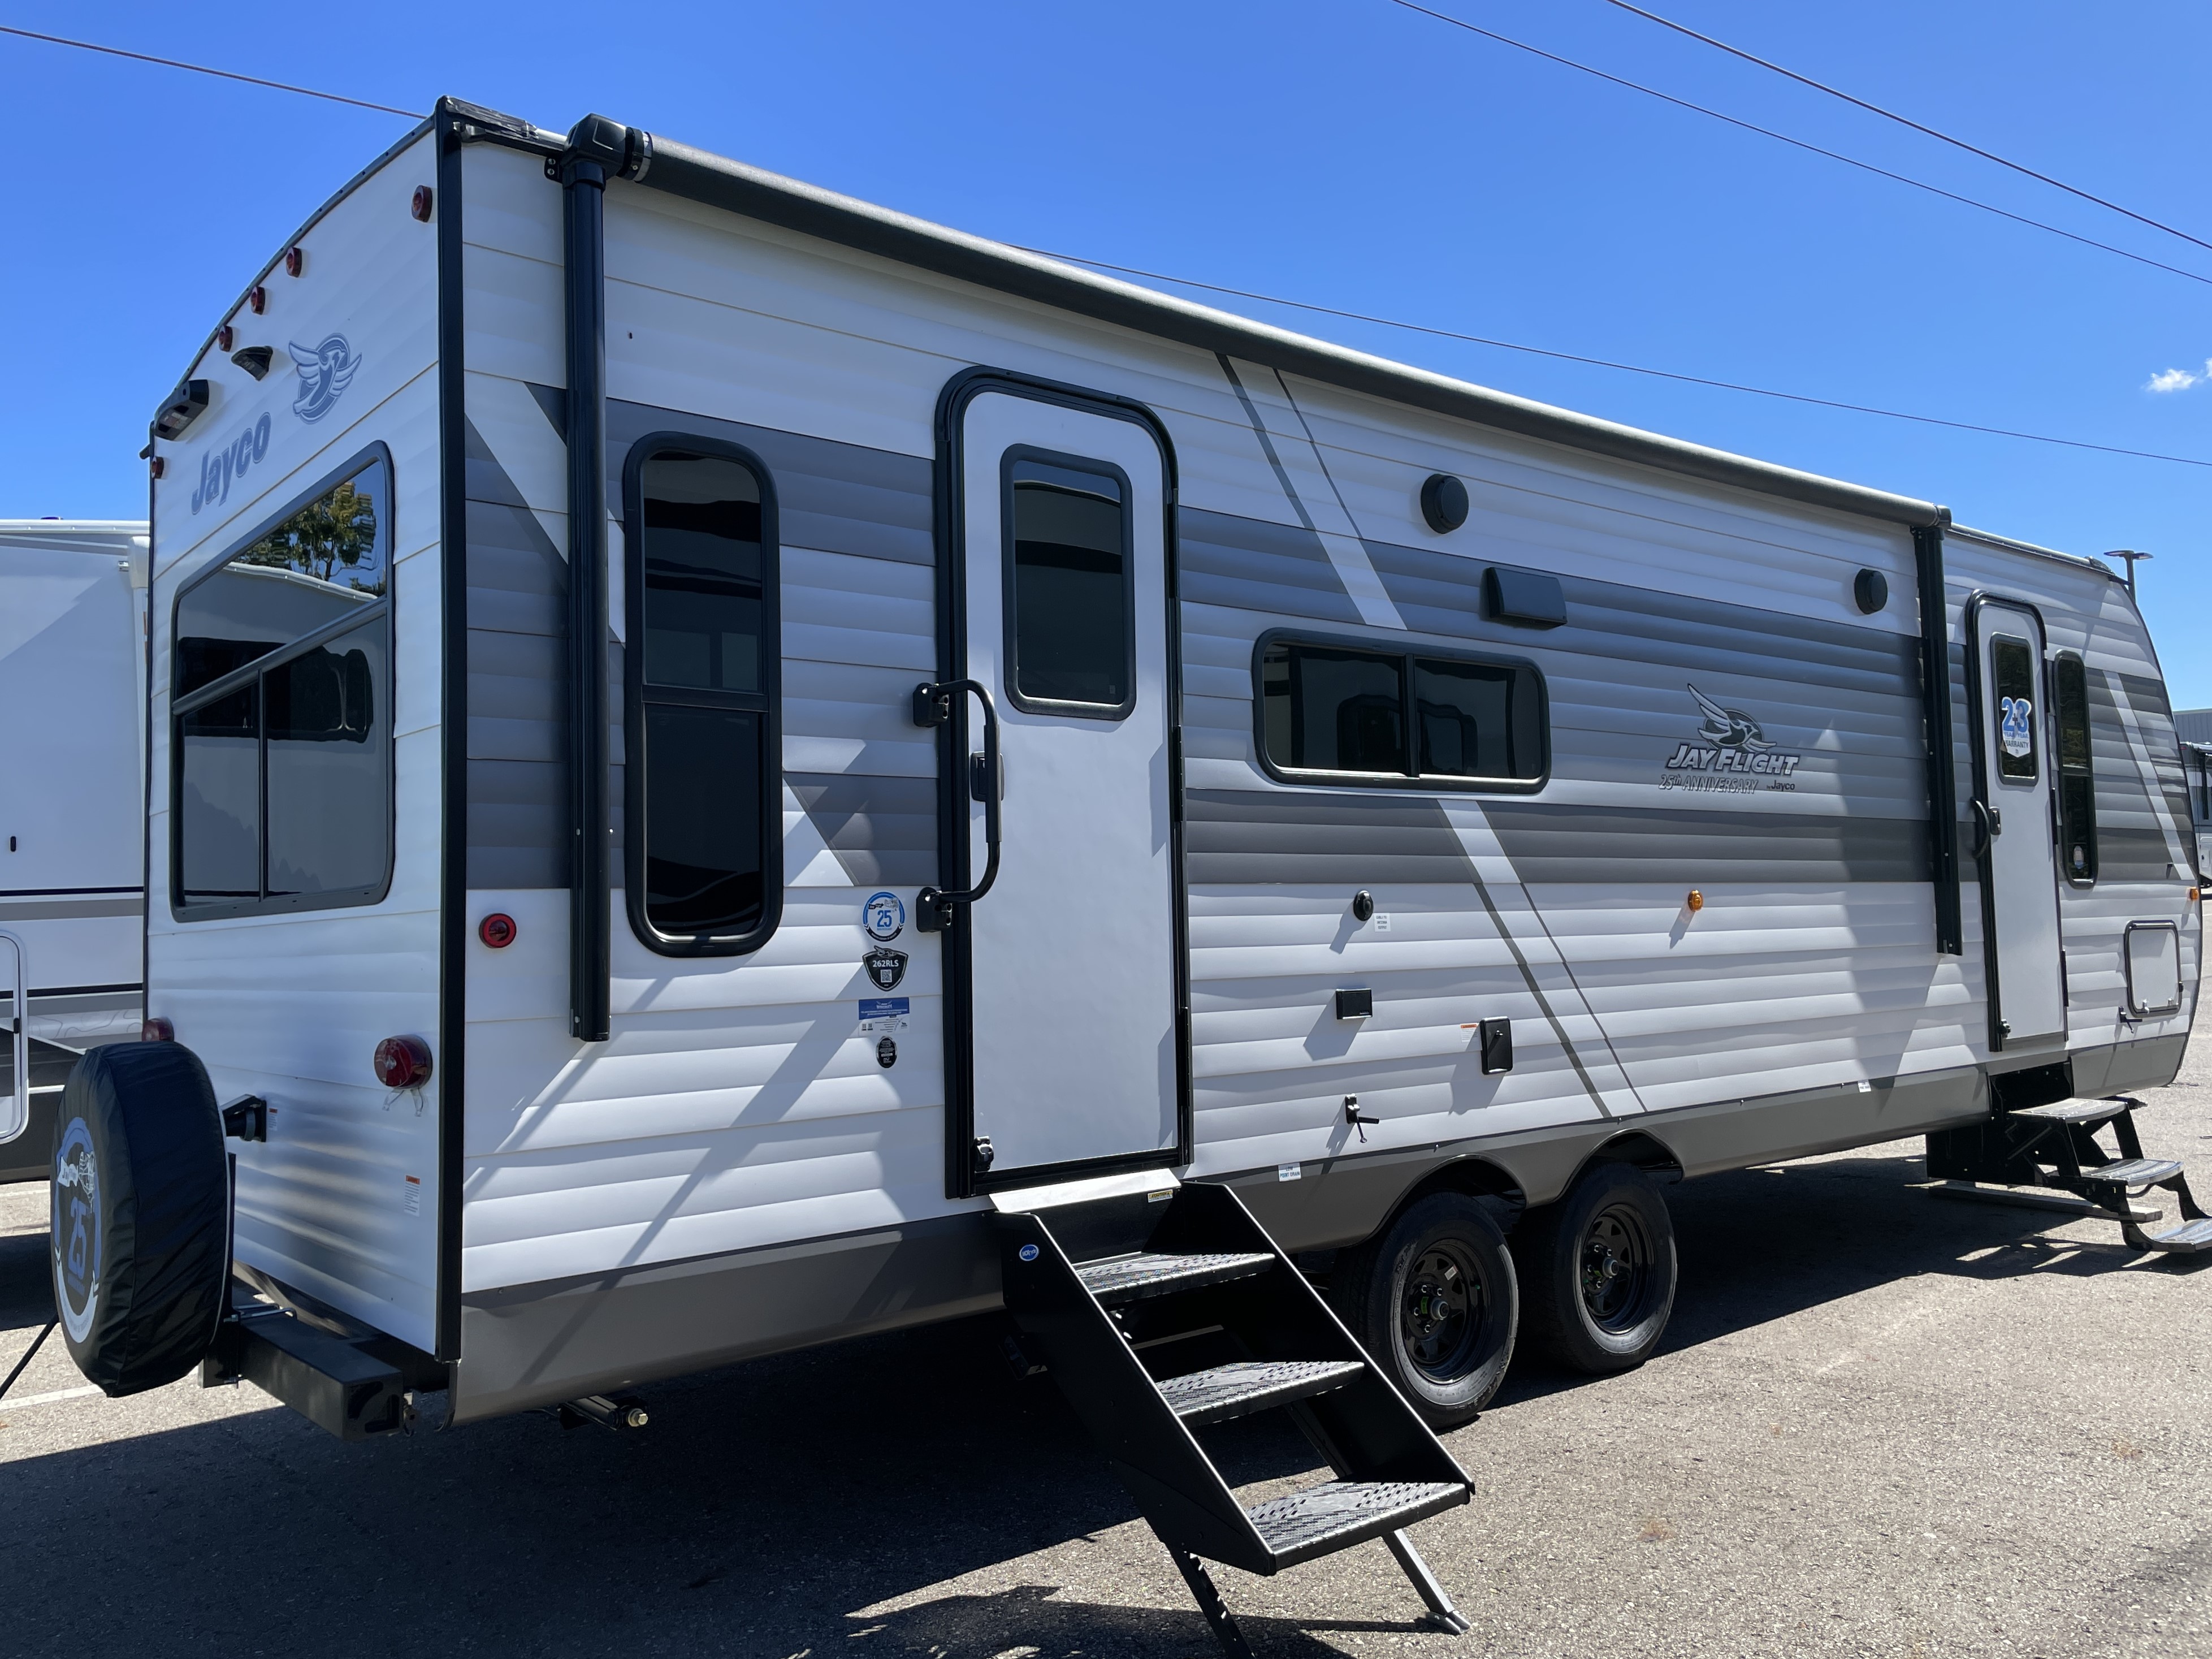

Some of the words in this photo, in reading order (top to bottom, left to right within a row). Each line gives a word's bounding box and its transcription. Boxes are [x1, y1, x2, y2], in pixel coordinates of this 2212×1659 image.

[192, 412, 271, 515] Jayco
[1666, 742, 1718, 769] JAY
[1714, 748, 1800, 776] FLIGHT
[1659, 775, 1682, 789] 25th
[1682, 776, 1759, 794] ANNIVERSARY
[1771, 780, 1795, 792] Jayco
[877, 910, 892, 927] 25
